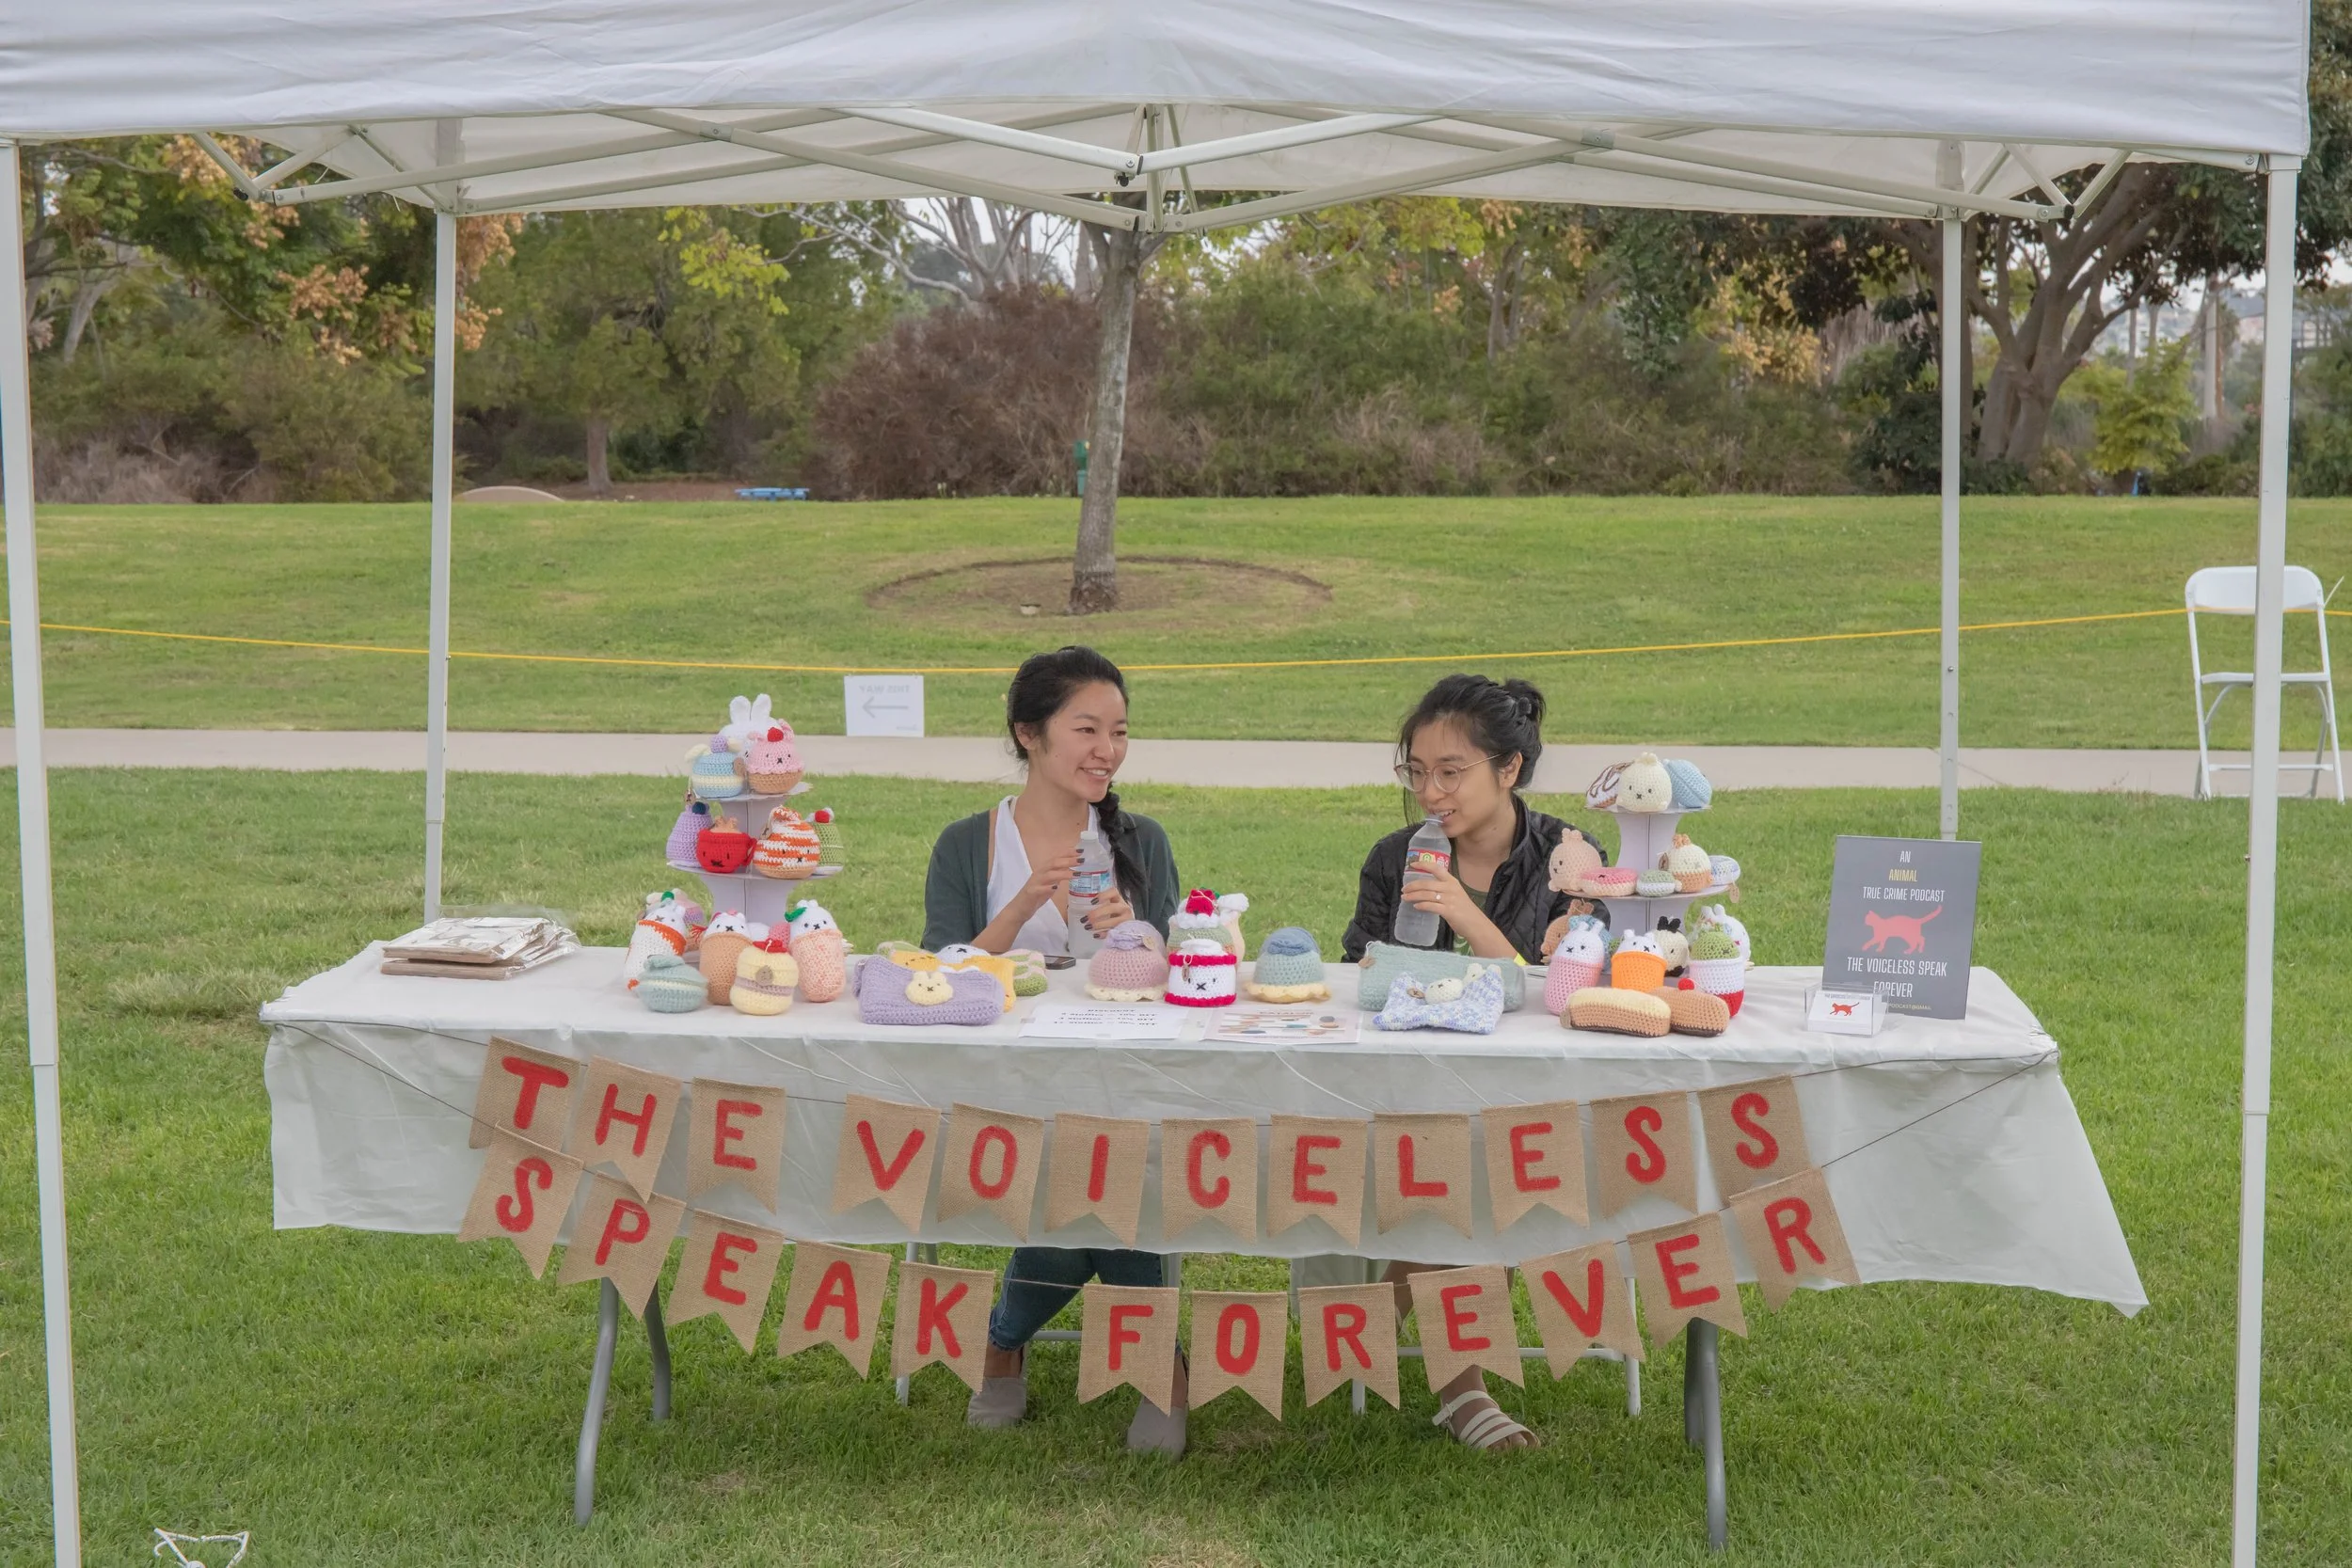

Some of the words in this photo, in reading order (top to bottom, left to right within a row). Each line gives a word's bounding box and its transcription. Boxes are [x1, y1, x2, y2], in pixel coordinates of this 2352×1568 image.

[1899, 850, 1912, 863] AN
[1888, 868, 1918, 882] ANIMAL
[1863, 886, 1882, 899] TRUE
[1883, 887, 1908, 901] CRIME
[1910, 888, 1946, 902] PODCAST
[1847, 957, 1864, 973] THE
[1867, 958, 1915, 975] VOICELESS
[1918, 960, 1947, 976] SPEAK
[503, 1057, 760, 1169] THE
[857, 1093, 1778, 1207] VOICELESS
[496, 1158, 968, 1357] SPEAK
[1108, 1197, 1826, 1375] FOREVER
